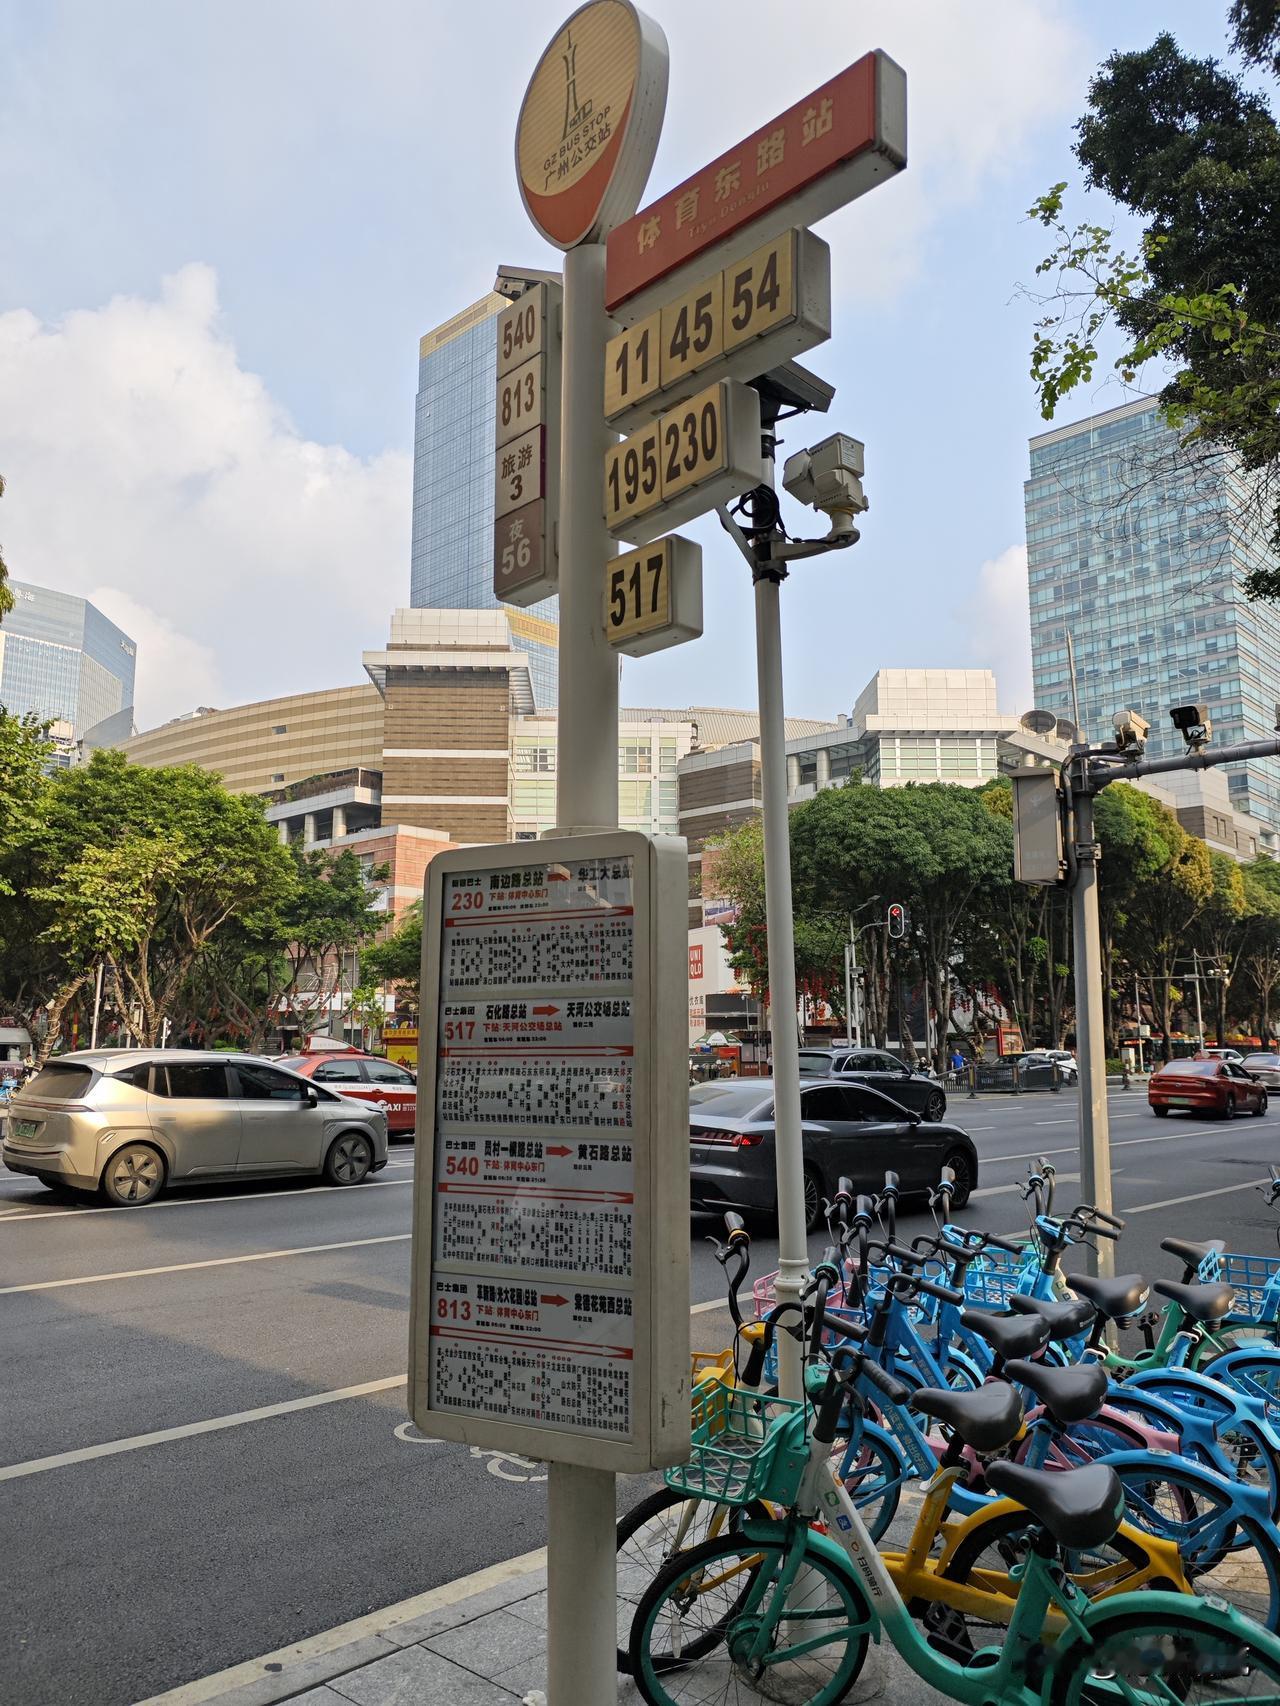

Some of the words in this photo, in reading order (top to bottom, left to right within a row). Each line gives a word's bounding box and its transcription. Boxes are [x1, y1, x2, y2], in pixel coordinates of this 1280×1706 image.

[544, 153, 557, 171] GZ
[560, 134, 580, 158] BUS
[583, 106, 611, 138] STOP
[544, 122, 612, 192] 广州公交站
[637, 98, 833, 255] 体育东路站
[503, 303, 536, 360] 540
[616, 328, 650, 397] 11
[669, 290, 713, 363] 45
[731, 250, 780, 331] 54
[501, 372, 534, 427] 813
[501, 443, 533, 480] 旅游
[608, 435, 657, 513] 195
[665, 401, 718, 484] 230
[510, 474, 523, 501] 3
[509, 518, 524, 541] 夜
[501, 536, 531, 576] 56
[610, 554, 664, 627] 517
[451, 891, 484, 911] 230
[689, 949, 701, 961] UNI
[690, 963, 702, 977] QLO
[486, 1004, 527, 1020] 石化路总站
[566, 1000, 631, 1018] 天河公交场总站
[445, 1021, 475, 1040] 517
[446, 1156, 479, 1176] 540
[578, 1144, 632, 1162] 黄石路总站
[437, 1298, 471, 1321] 813
